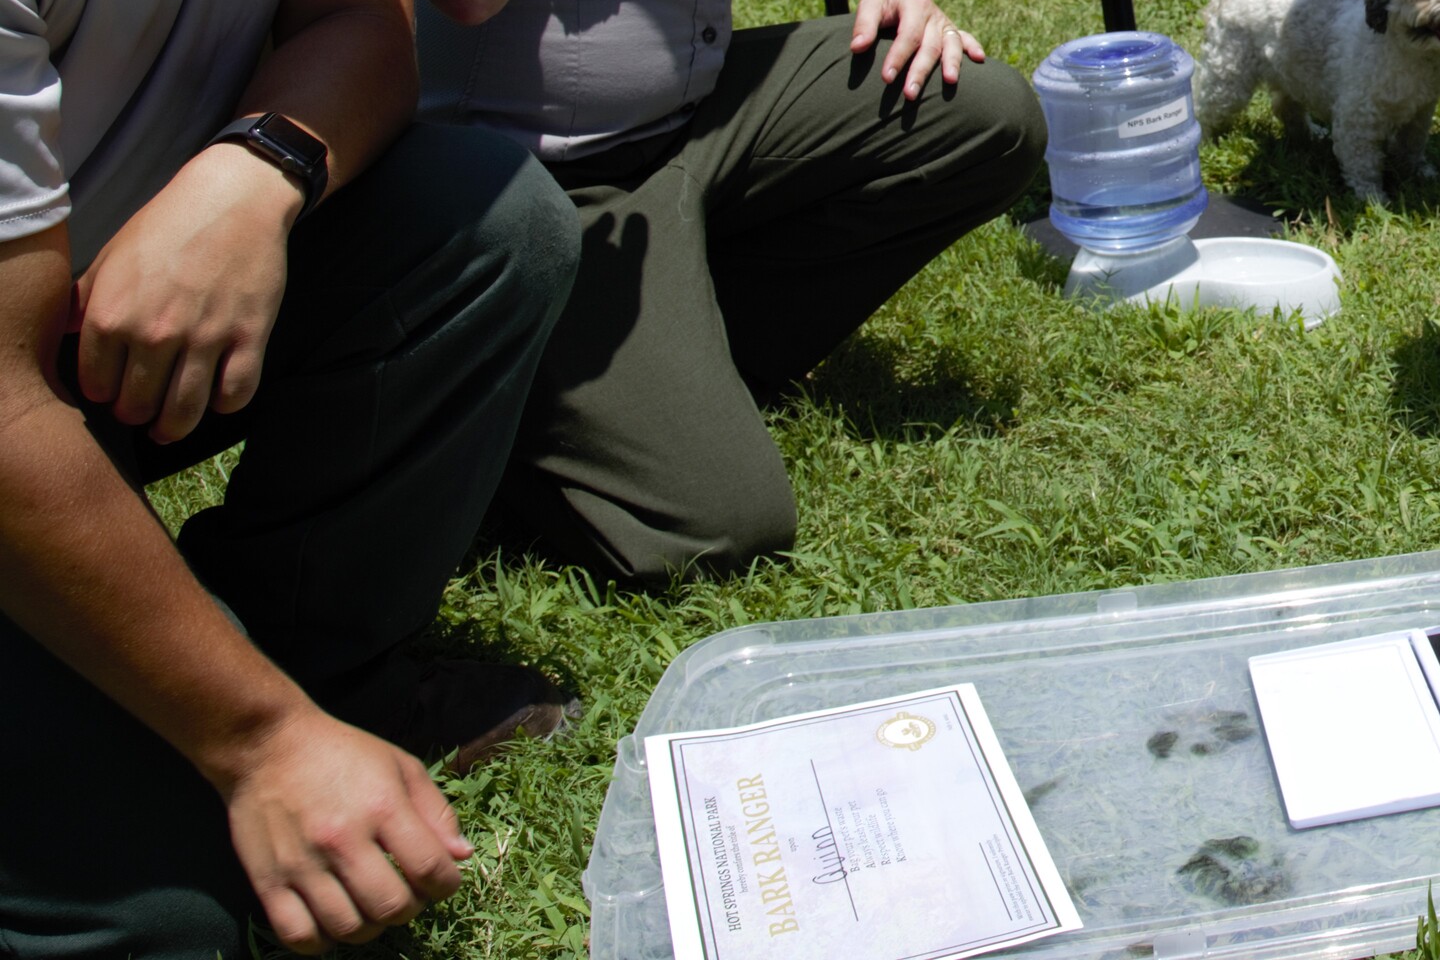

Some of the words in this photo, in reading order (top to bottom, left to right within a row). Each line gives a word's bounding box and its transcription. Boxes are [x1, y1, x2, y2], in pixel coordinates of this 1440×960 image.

[1128, 119, 1144, 128] NPS
[1146, 115, 1162, 124] Bark
[1164, 108, 1182, 119] Ranger
[875, 787, 887, 797] go
[704, 796, 720, 820] PARK
[848, 800, 861, 811] pet
[879, 797, 888, 809] can
[737, 773, 782, 865] RANGER
[852, 811, 863, 827] your
[883, 808, 896, 821] you
[727, 831, 738, 842] title
[855, 826, 868, 845] leash
[866, 814, 882, 839] wildlife
[887, 821, 900, 841] where
[709, 821, 728, 868] NATIONAL
[730, 842, 740, 852] the
[788, 837, 799, 852] upon
[845, 842, 857, 858] your
[876, 839, 891, 865] Respect
[895, 842, 907, 862] Know
[732, 852, 745, 872] confers
[812, 826, 848, 884] Quinn
[850, 858, 861, 872] Bag
[863, 844, 876, 868] Always
[718, 870, 737, 910] SPRINGS
[737, 874, 749, 893] hereby
[757, 866, 800, 937] BARK
[726, 911, 741, 931] HOT
